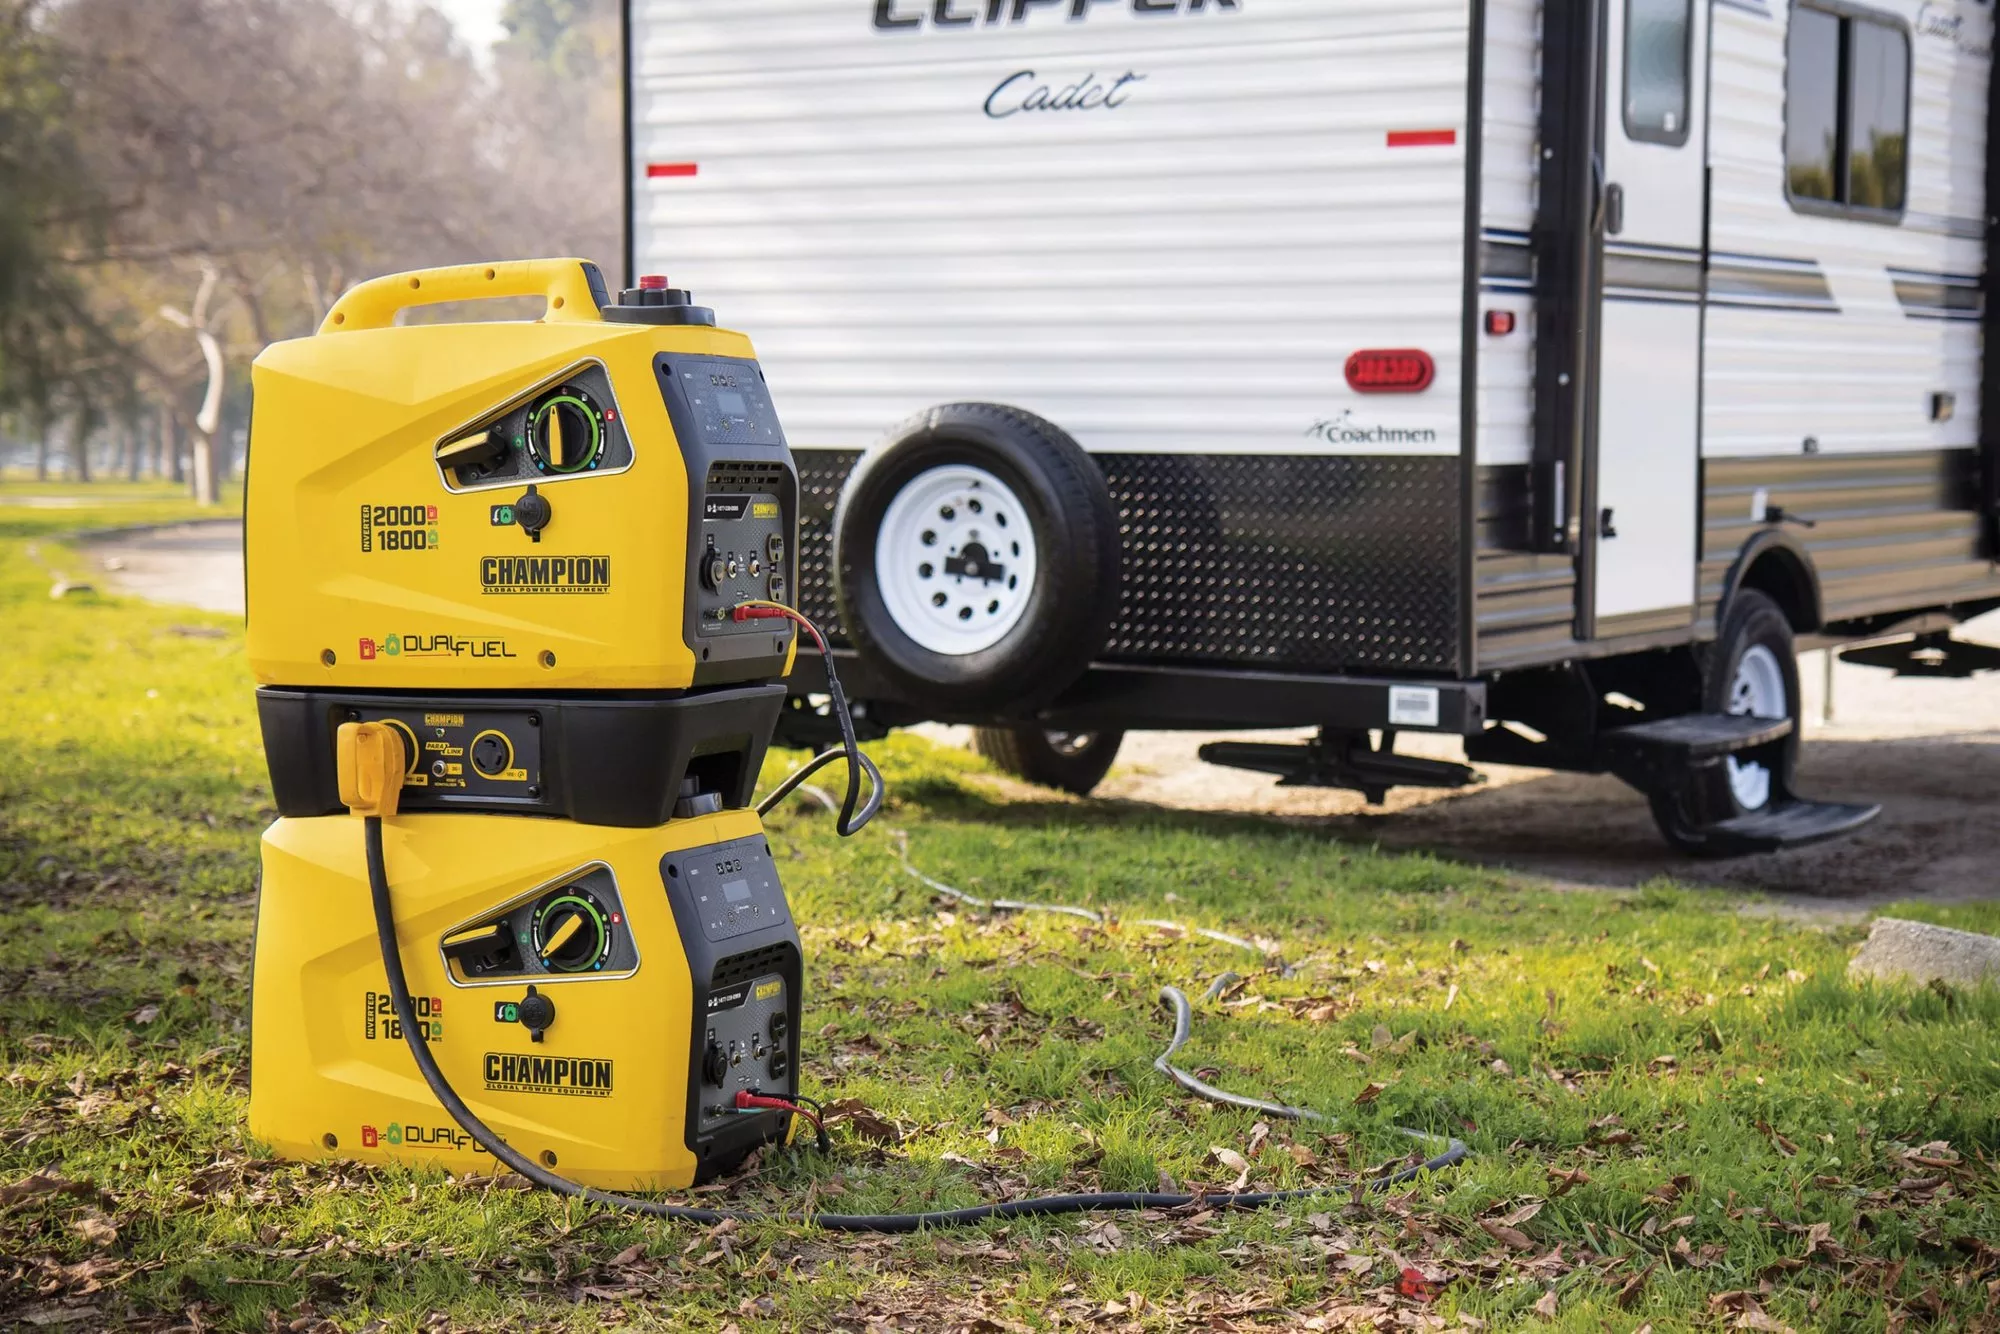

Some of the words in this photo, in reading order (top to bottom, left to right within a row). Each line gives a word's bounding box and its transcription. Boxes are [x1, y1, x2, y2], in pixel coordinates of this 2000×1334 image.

[983, 69, 1146, 119] Cadet
[1326, 425, 1436, 443] Coachmen
[373, 505, 426, 526] 2000
[362, 506, 371, 551] INVERTER
[378, 530, 426, 550] 1800
[482, 557, 609, 585] CHAMPION
[425, 714, 464, 724] CHAMPION
[366, 993, 375, 1038] INVERTER
[378, 994, 430, 1017] 20
[381, 1019, 430, 1041] 180
[485, 1054, 611, 1088] CHAMPION
[558, 1088, 611, 1096] EQUIPMENT
